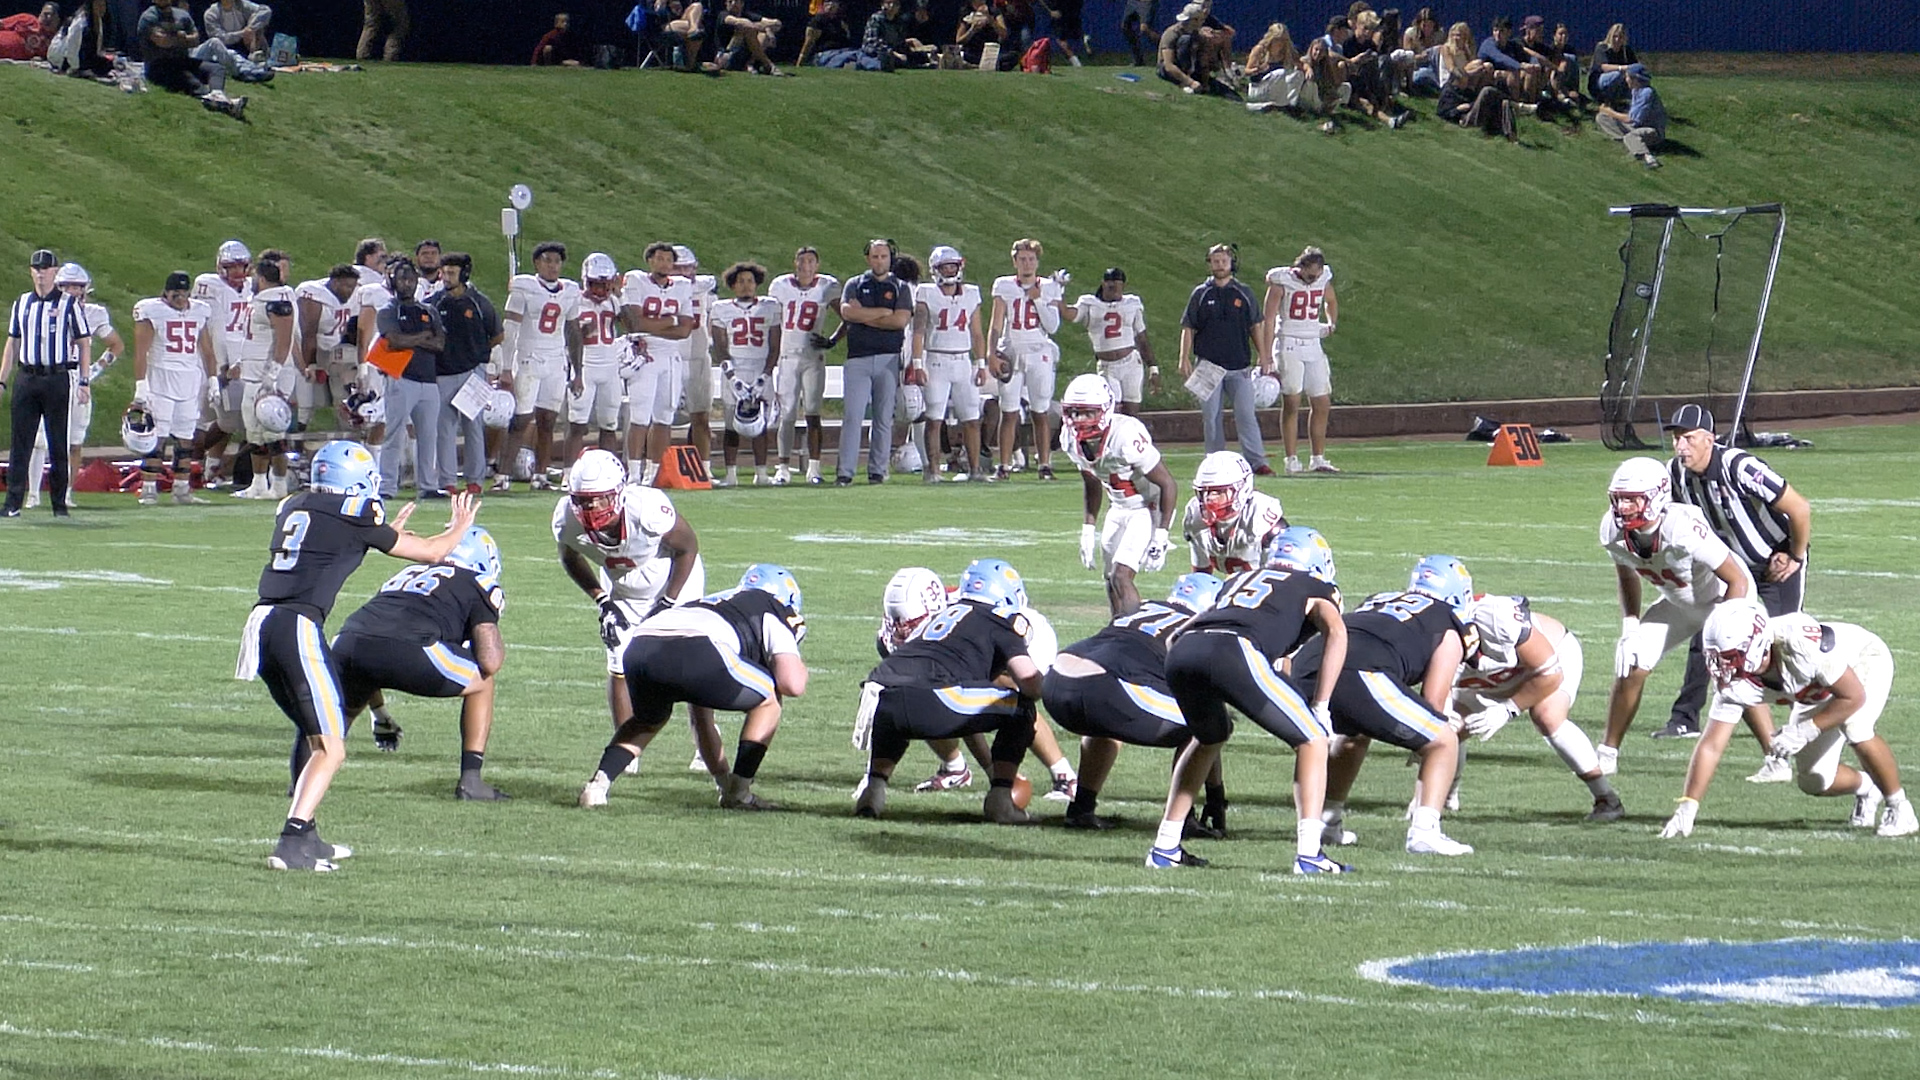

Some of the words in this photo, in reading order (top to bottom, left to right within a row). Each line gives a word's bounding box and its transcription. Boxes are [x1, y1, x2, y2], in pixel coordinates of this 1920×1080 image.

[538, 302, 560, 334] 8
[784, 300, 819, 332] 18
[936, 308, 968, 332] 14
[1289, 290, 1323, 320] 85
[166, 321, 198, 354] 55
[579, 310, 614, 345] 20
[731, 317, 766, 347] 25
[1104, 312, 1122, 339] 2
[1133, 432, 1149, 454] 24
[1506, 426, 1542, 460] 30
[676, 447, 709, 483] 40
[660, 505, 673, 518] 9
[272, 510, 310, 571] 3
[1216, 569, 1292, 610] 15
